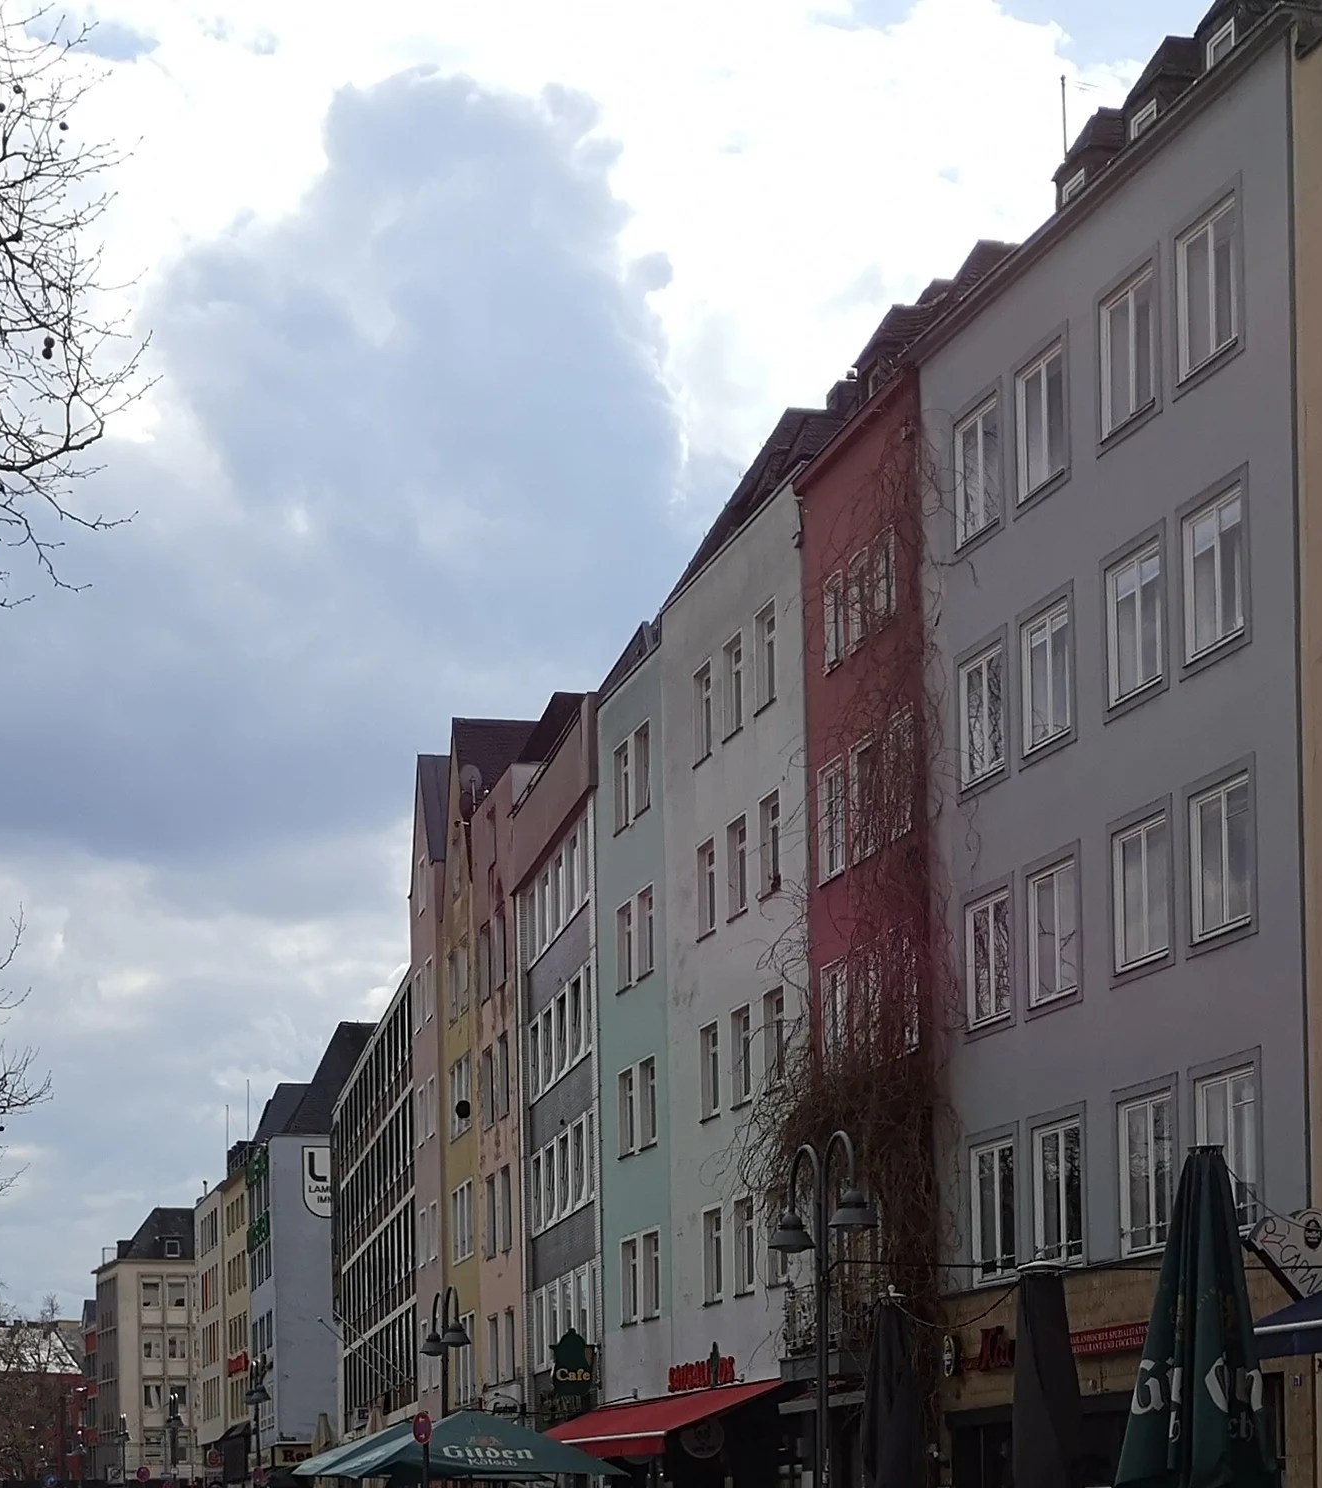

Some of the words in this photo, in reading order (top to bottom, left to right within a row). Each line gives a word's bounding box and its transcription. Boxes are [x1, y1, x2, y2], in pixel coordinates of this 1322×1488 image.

[555, 1367, 591, 1382] Cafe
[442, 1445, 534, 1460] Gilden
[468, 1458, 518, 1467] Kölsch
